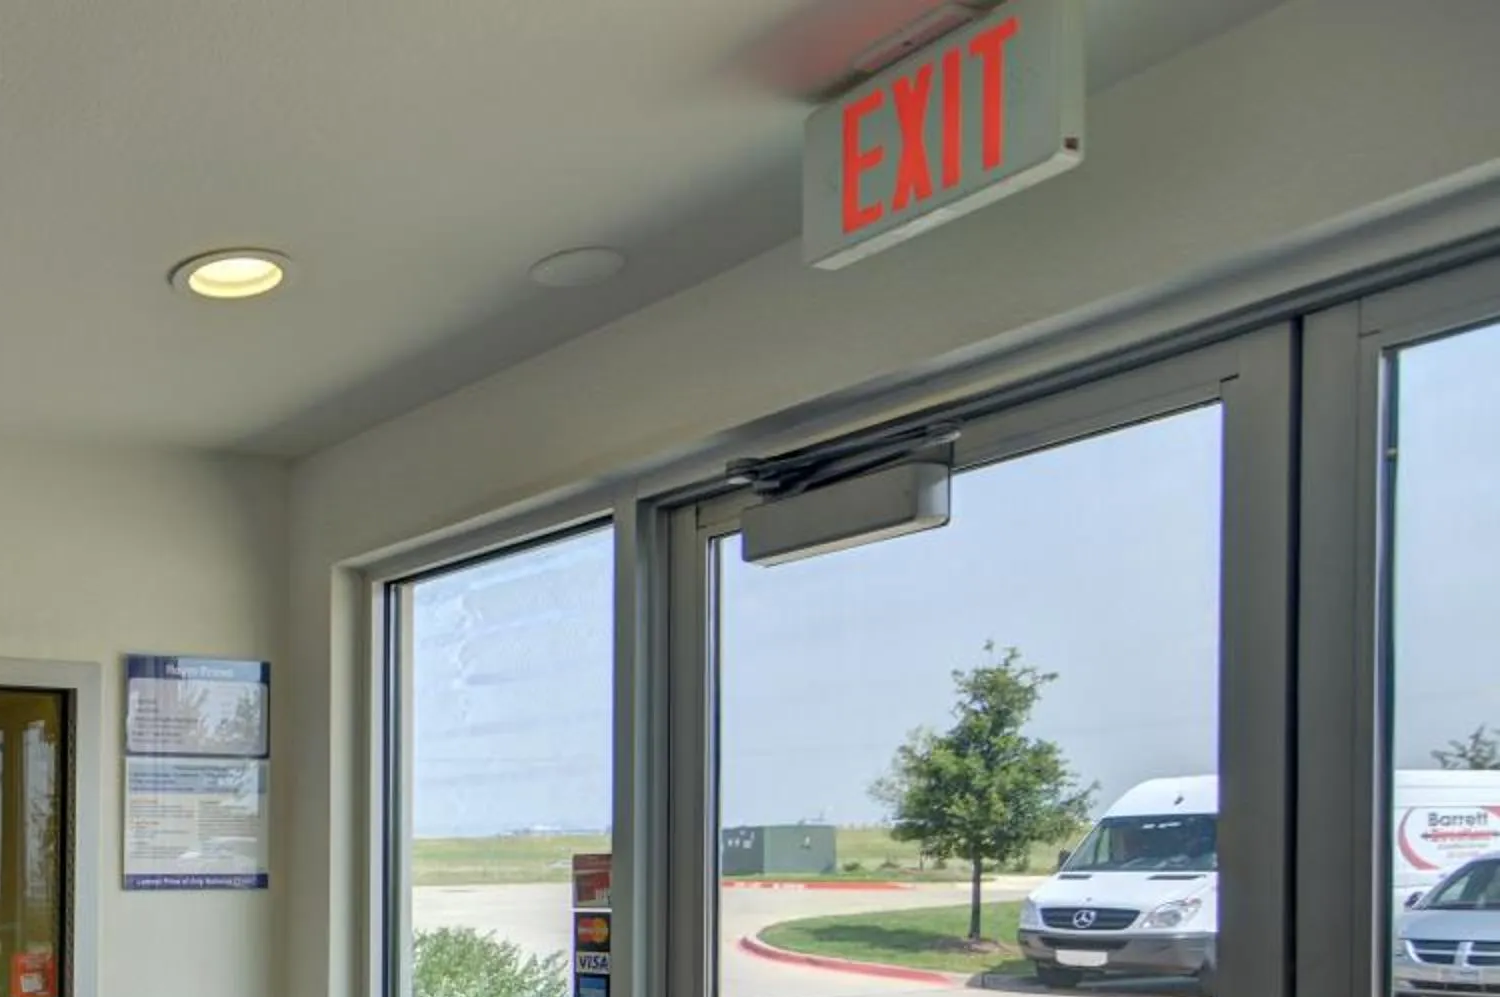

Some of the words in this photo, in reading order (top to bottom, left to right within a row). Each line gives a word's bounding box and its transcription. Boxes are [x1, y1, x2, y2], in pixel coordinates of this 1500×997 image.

[842, 16, 1020, 235] EXIT
[1427, 812, 1488, 827] Barrett
[579, 955, 609, 970] VISA
